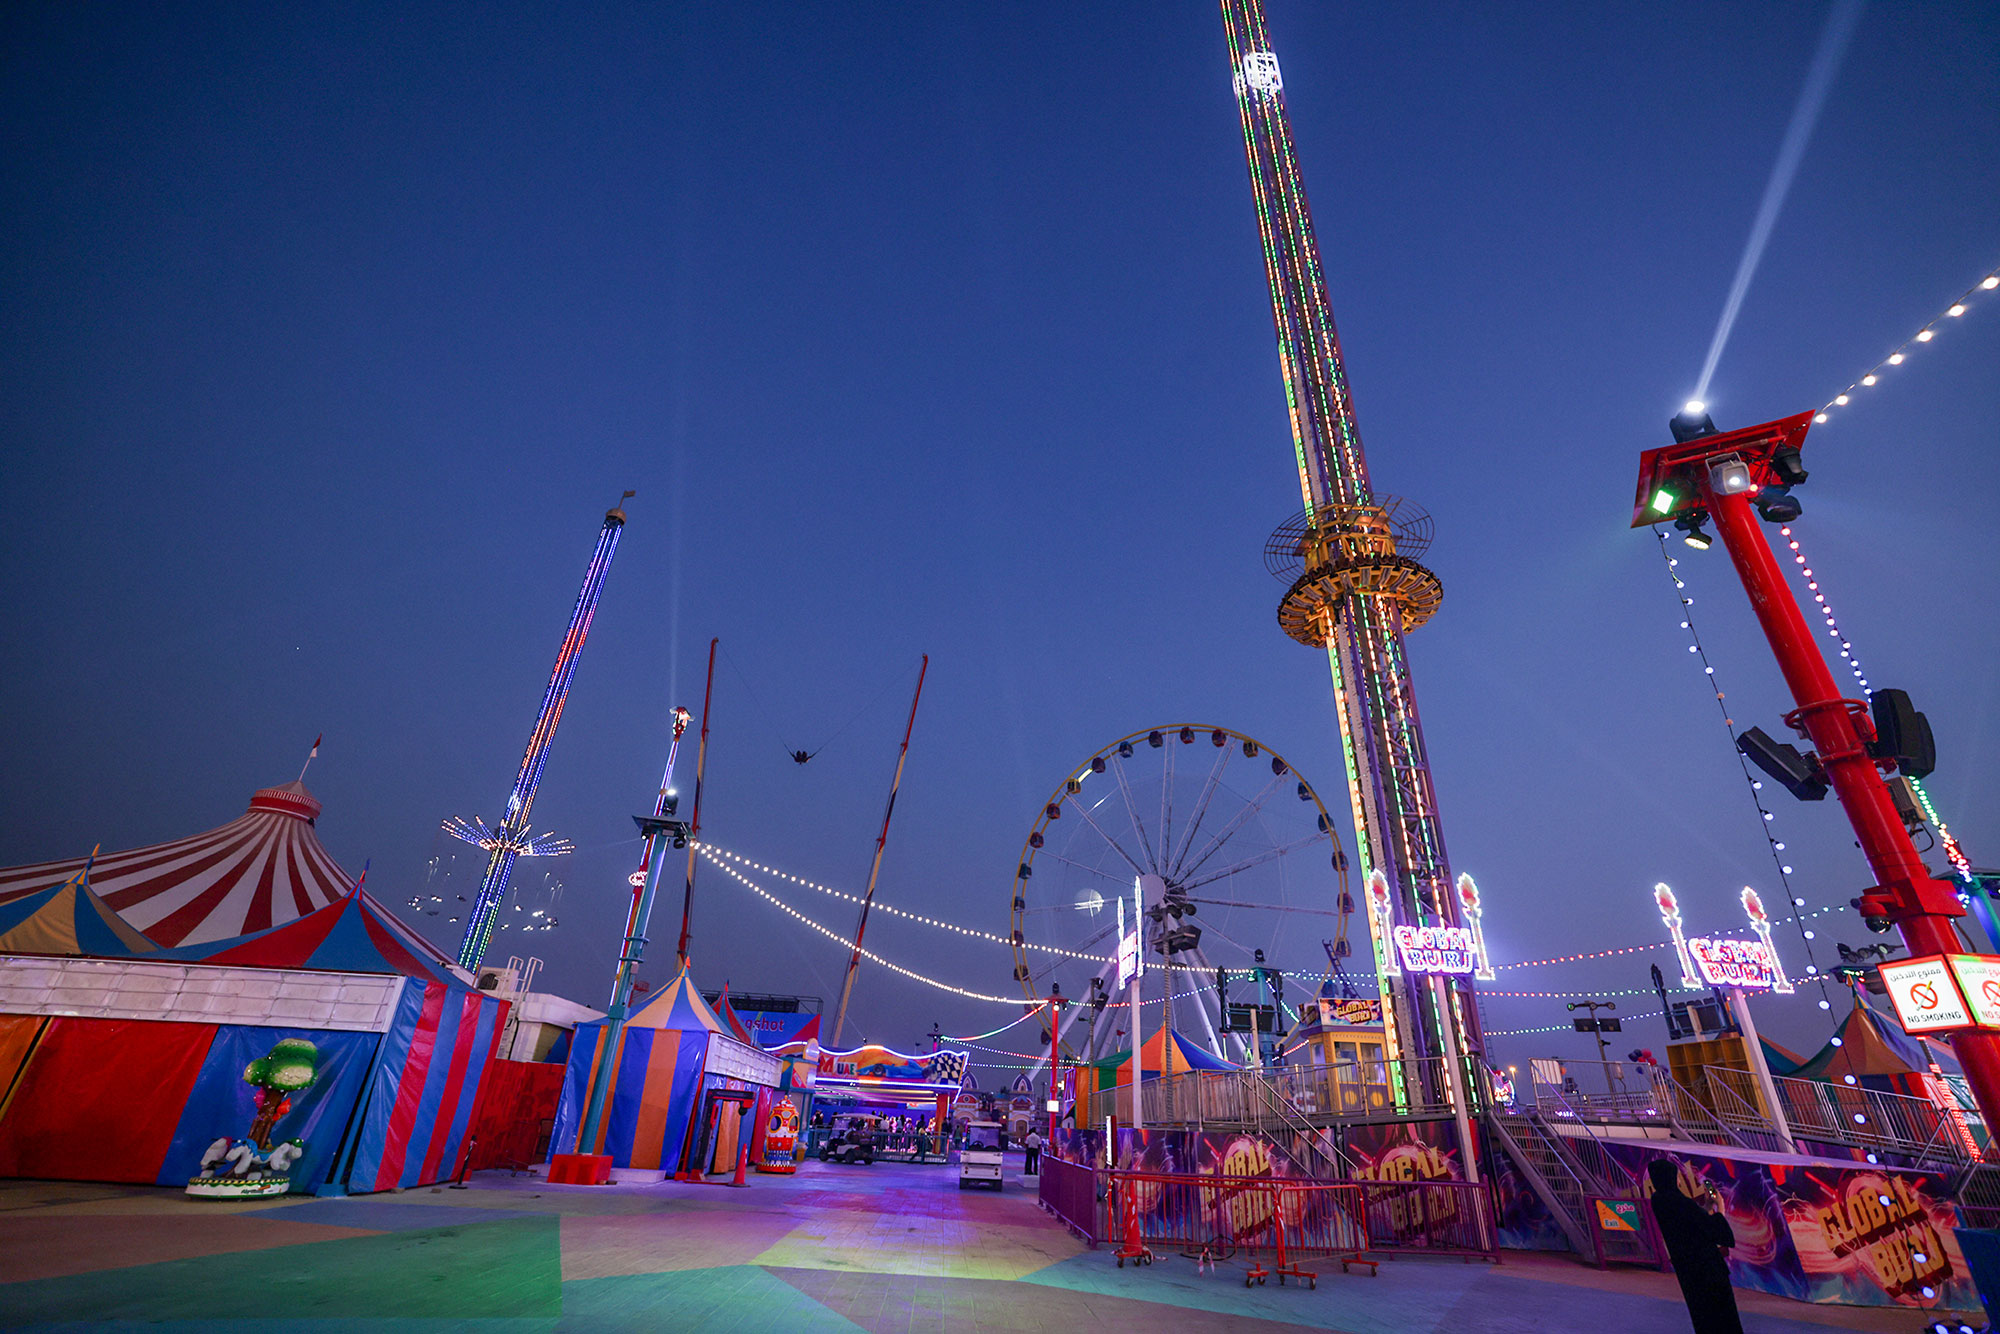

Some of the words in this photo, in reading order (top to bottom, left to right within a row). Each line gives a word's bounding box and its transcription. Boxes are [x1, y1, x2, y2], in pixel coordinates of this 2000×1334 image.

[1394, 925, 1474, 951] GLOBAL
[1402, 948, 1474, 973] BURJ
[1336, 1000, 1369, 1016] GLOBAL
[741, 1017, 784, 1031] gshot
[1907, 1014, 1920, 1024] NO
[1921, 1011, 1962, 1023] SMOKING
[837, 1063, 855, 1075] UAE
[1818, 1174, 1920, 1251] GLOBAL
[1604, 1219, 1619, 1228] Exit
[1870, 1221, 1945, 1289] BURJ
